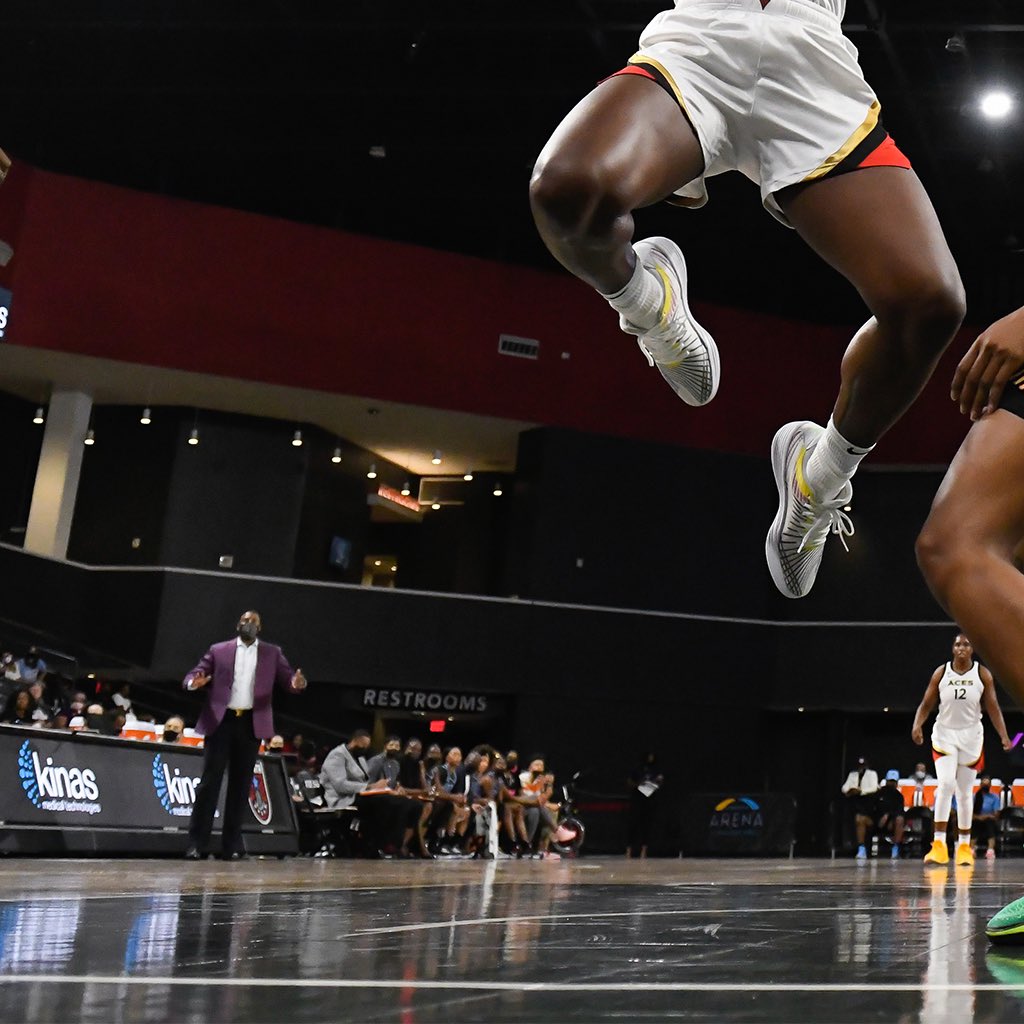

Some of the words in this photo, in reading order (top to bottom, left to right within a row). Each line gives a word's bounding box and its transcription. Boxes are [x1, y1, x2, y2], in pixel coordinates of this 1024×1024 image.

[363, 689, 488, 713] RESTROOMS
[954, 688, 967, 700] 12
[32, 751, 99, 801] kinas
